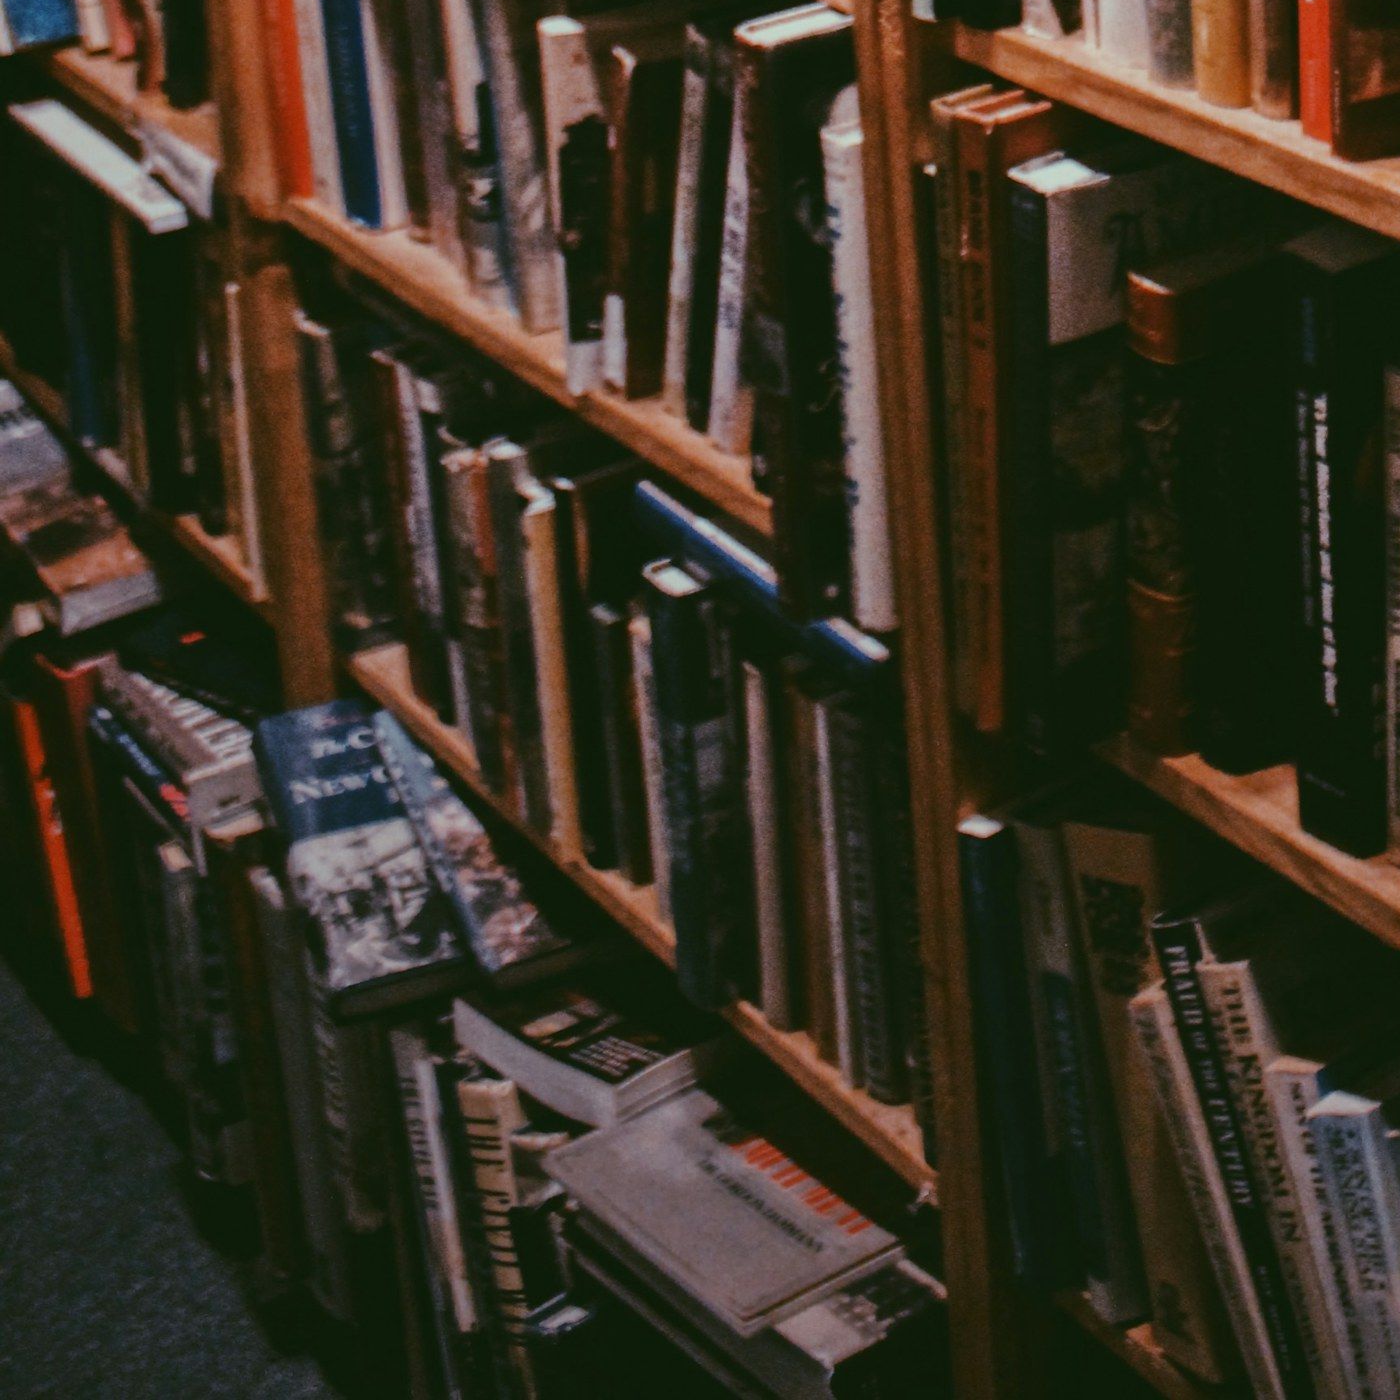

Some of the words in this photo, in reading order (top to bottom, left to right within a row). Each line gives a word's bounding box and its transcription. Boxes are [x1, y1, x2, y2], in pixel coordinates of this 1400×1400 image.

[1163, 944, 1204, 1026] FRAUD
[1222, 980, 1251, 1045] THE
[1237, 1053, 1289, 1198] KINGDOM
